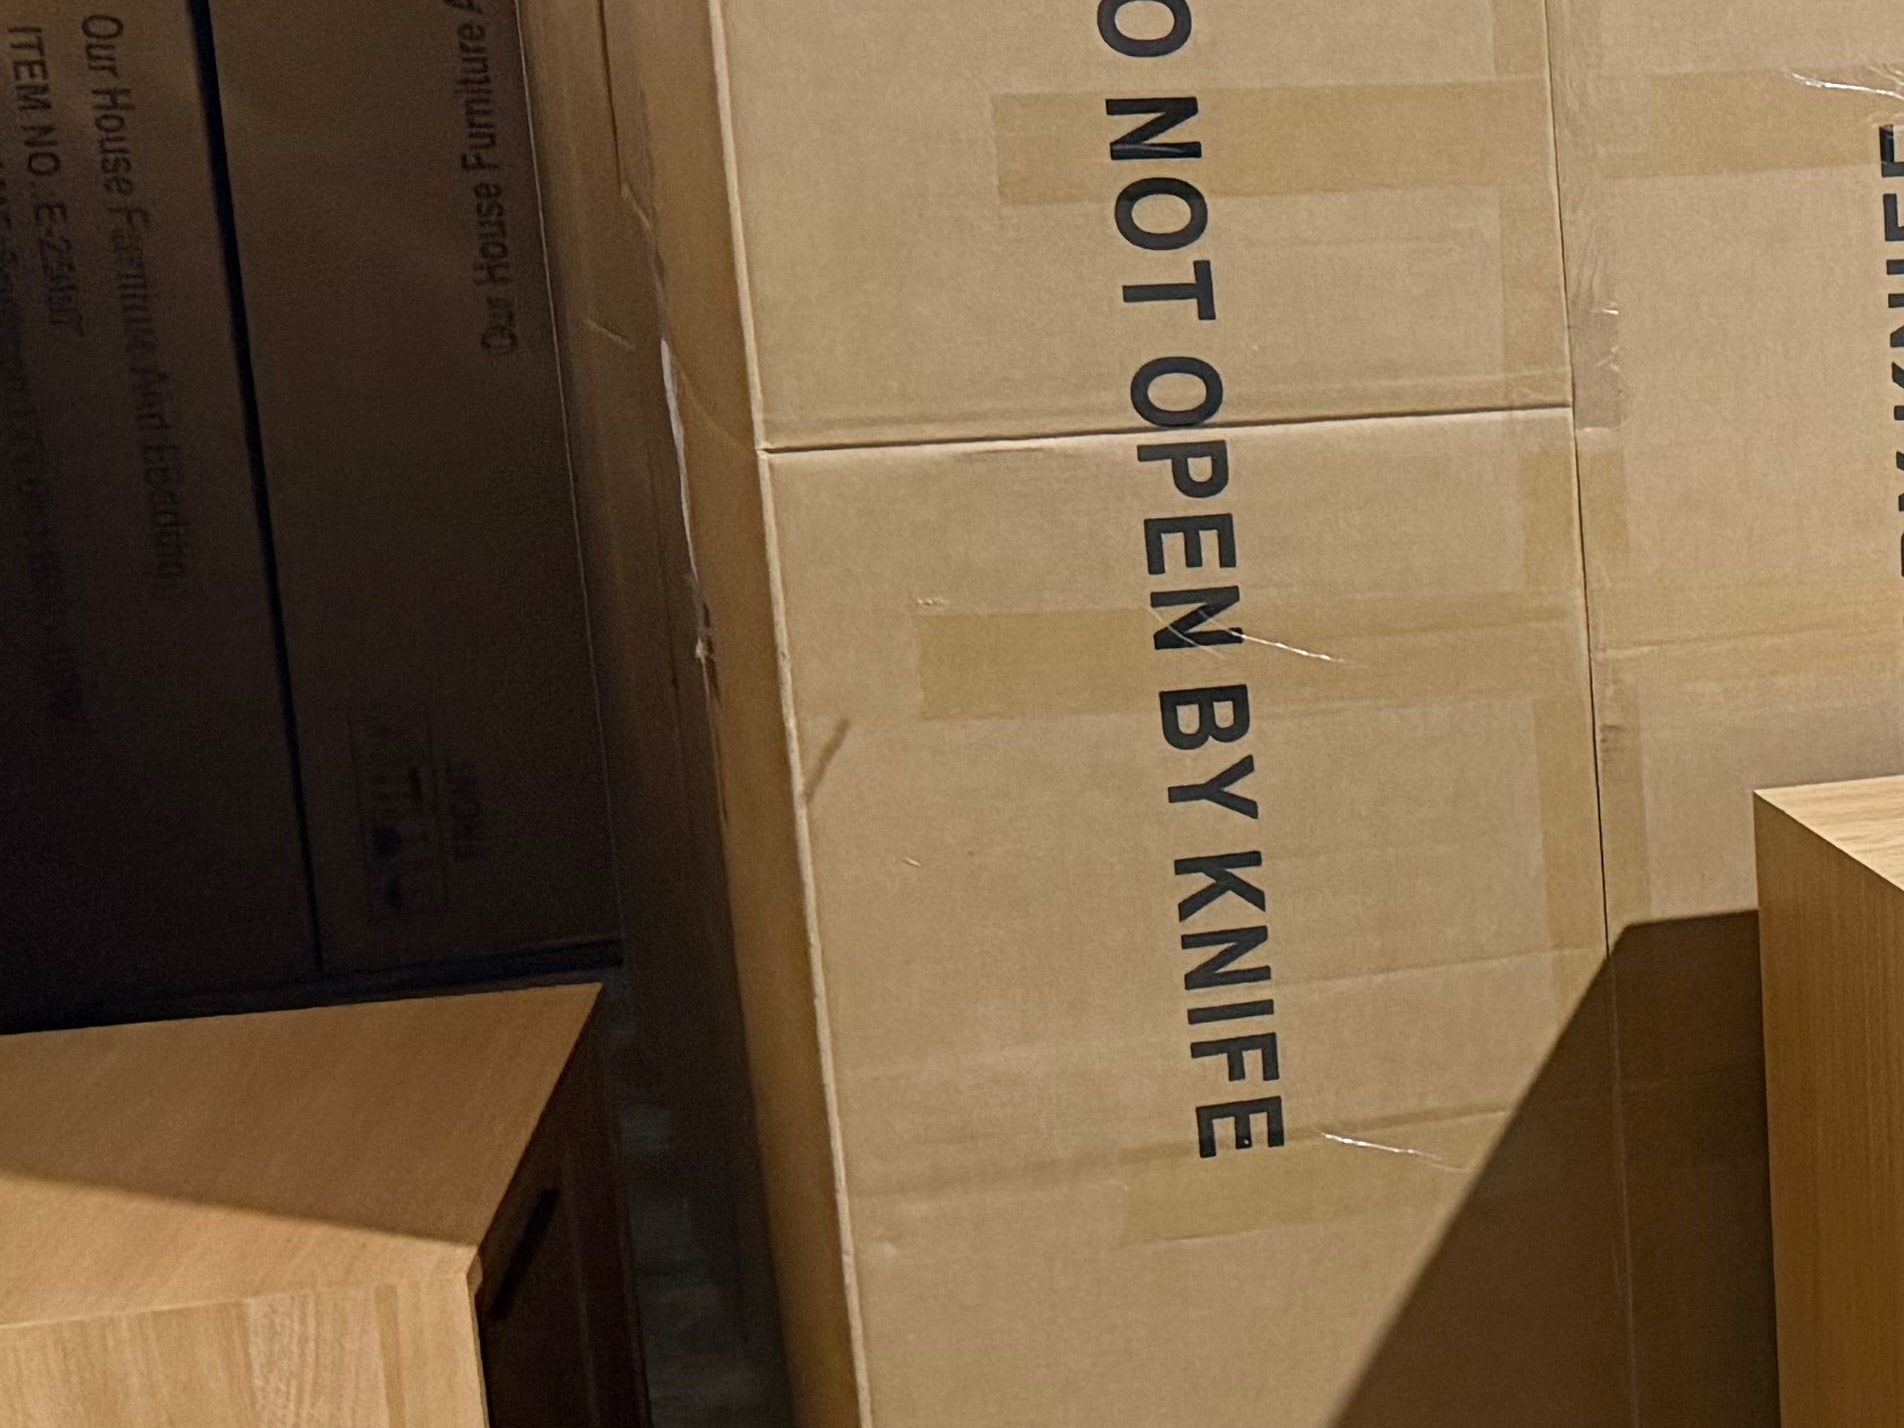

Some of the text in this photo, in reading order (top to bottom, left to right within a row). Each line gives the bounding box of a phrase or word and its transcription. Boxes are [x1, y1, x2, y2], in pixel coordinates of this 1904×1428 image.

[7, 25, 50, 111] ITEM
[81, 13, 124, 79] Our
[455, 22, 499, 172] Furniture
[91, 87, 136, 196] House
[1104, 95, 1217, 322] NOT
[473, 182, 512, 286] House
[1129, 355, 1245, 652] OPEN
[1157, 682, 1260, 821] BY
[1172, 849, 1286, 1160] KNIFE
